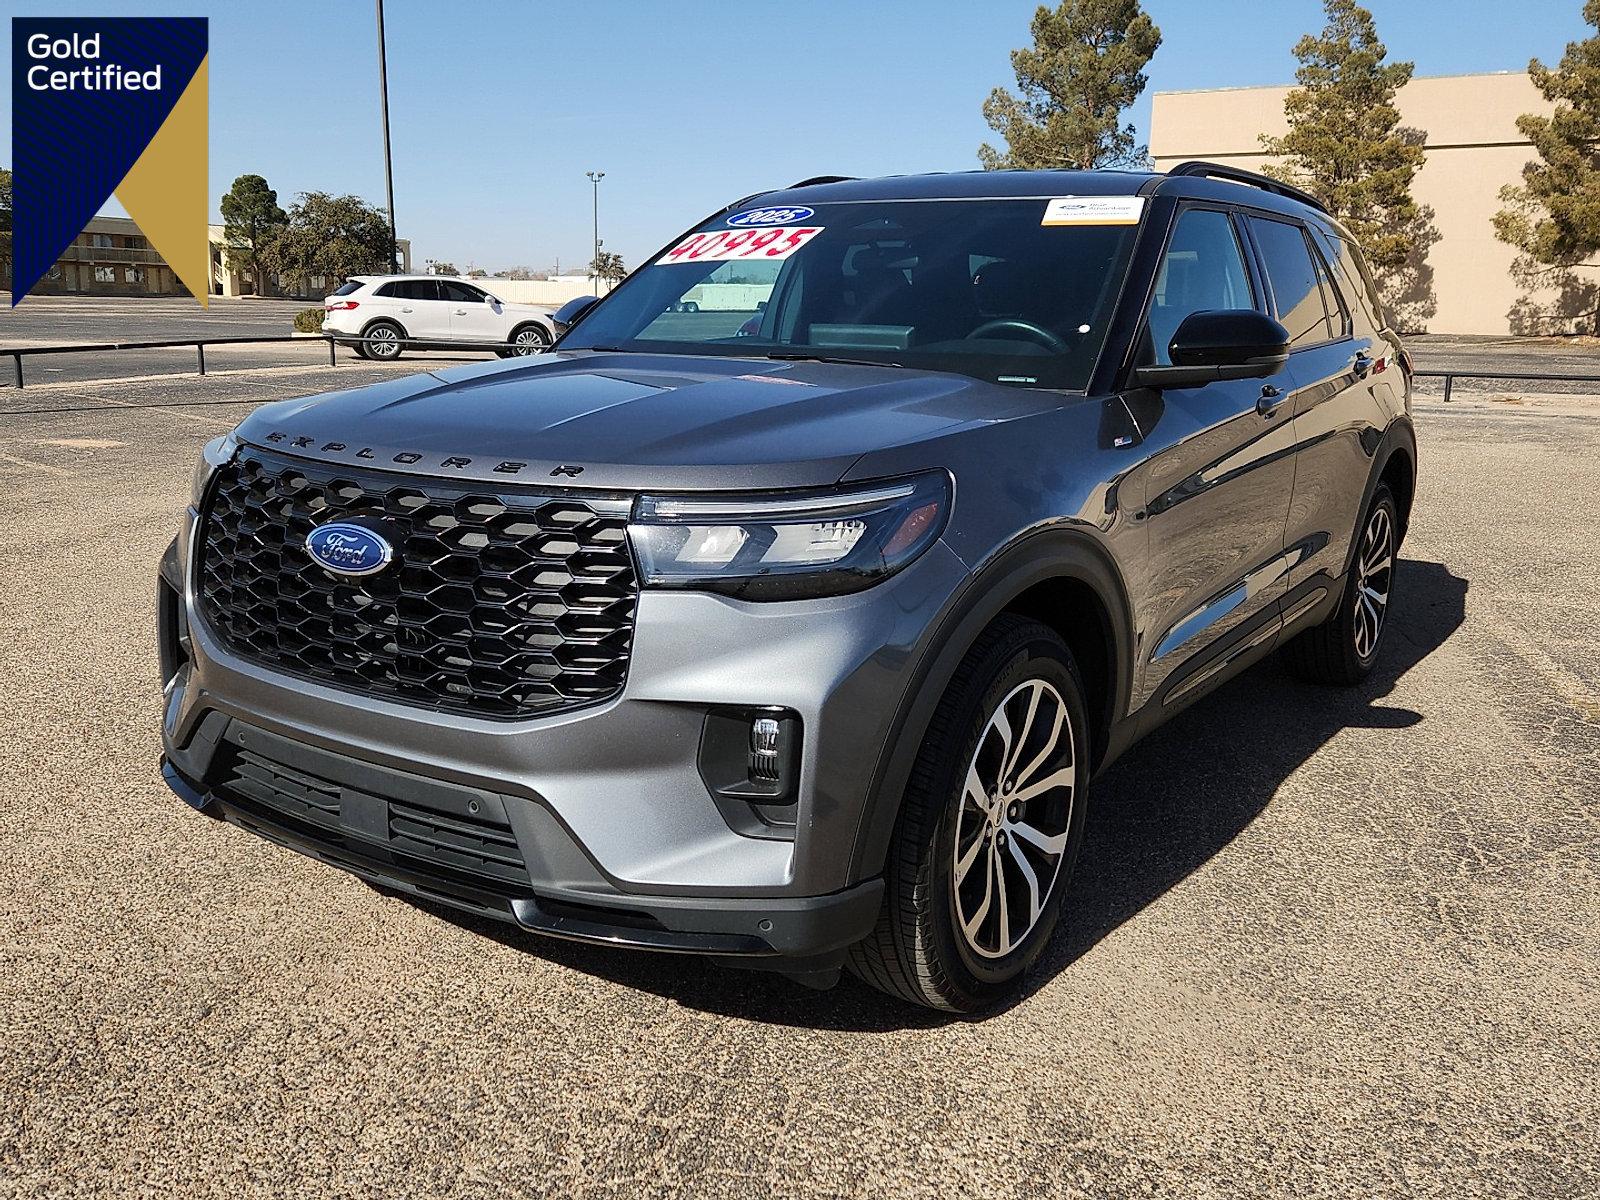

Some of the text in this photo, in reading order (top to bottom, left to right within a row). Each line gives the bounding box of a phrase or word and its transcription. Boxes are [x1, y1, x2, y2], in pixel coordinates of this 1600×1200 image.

[734, 209, 805, 224] 2025
[668, 228, 816, 261] 40995
[265, 431, 585, 478] EXPLORER
[321, 533, 369, 565] Ford
